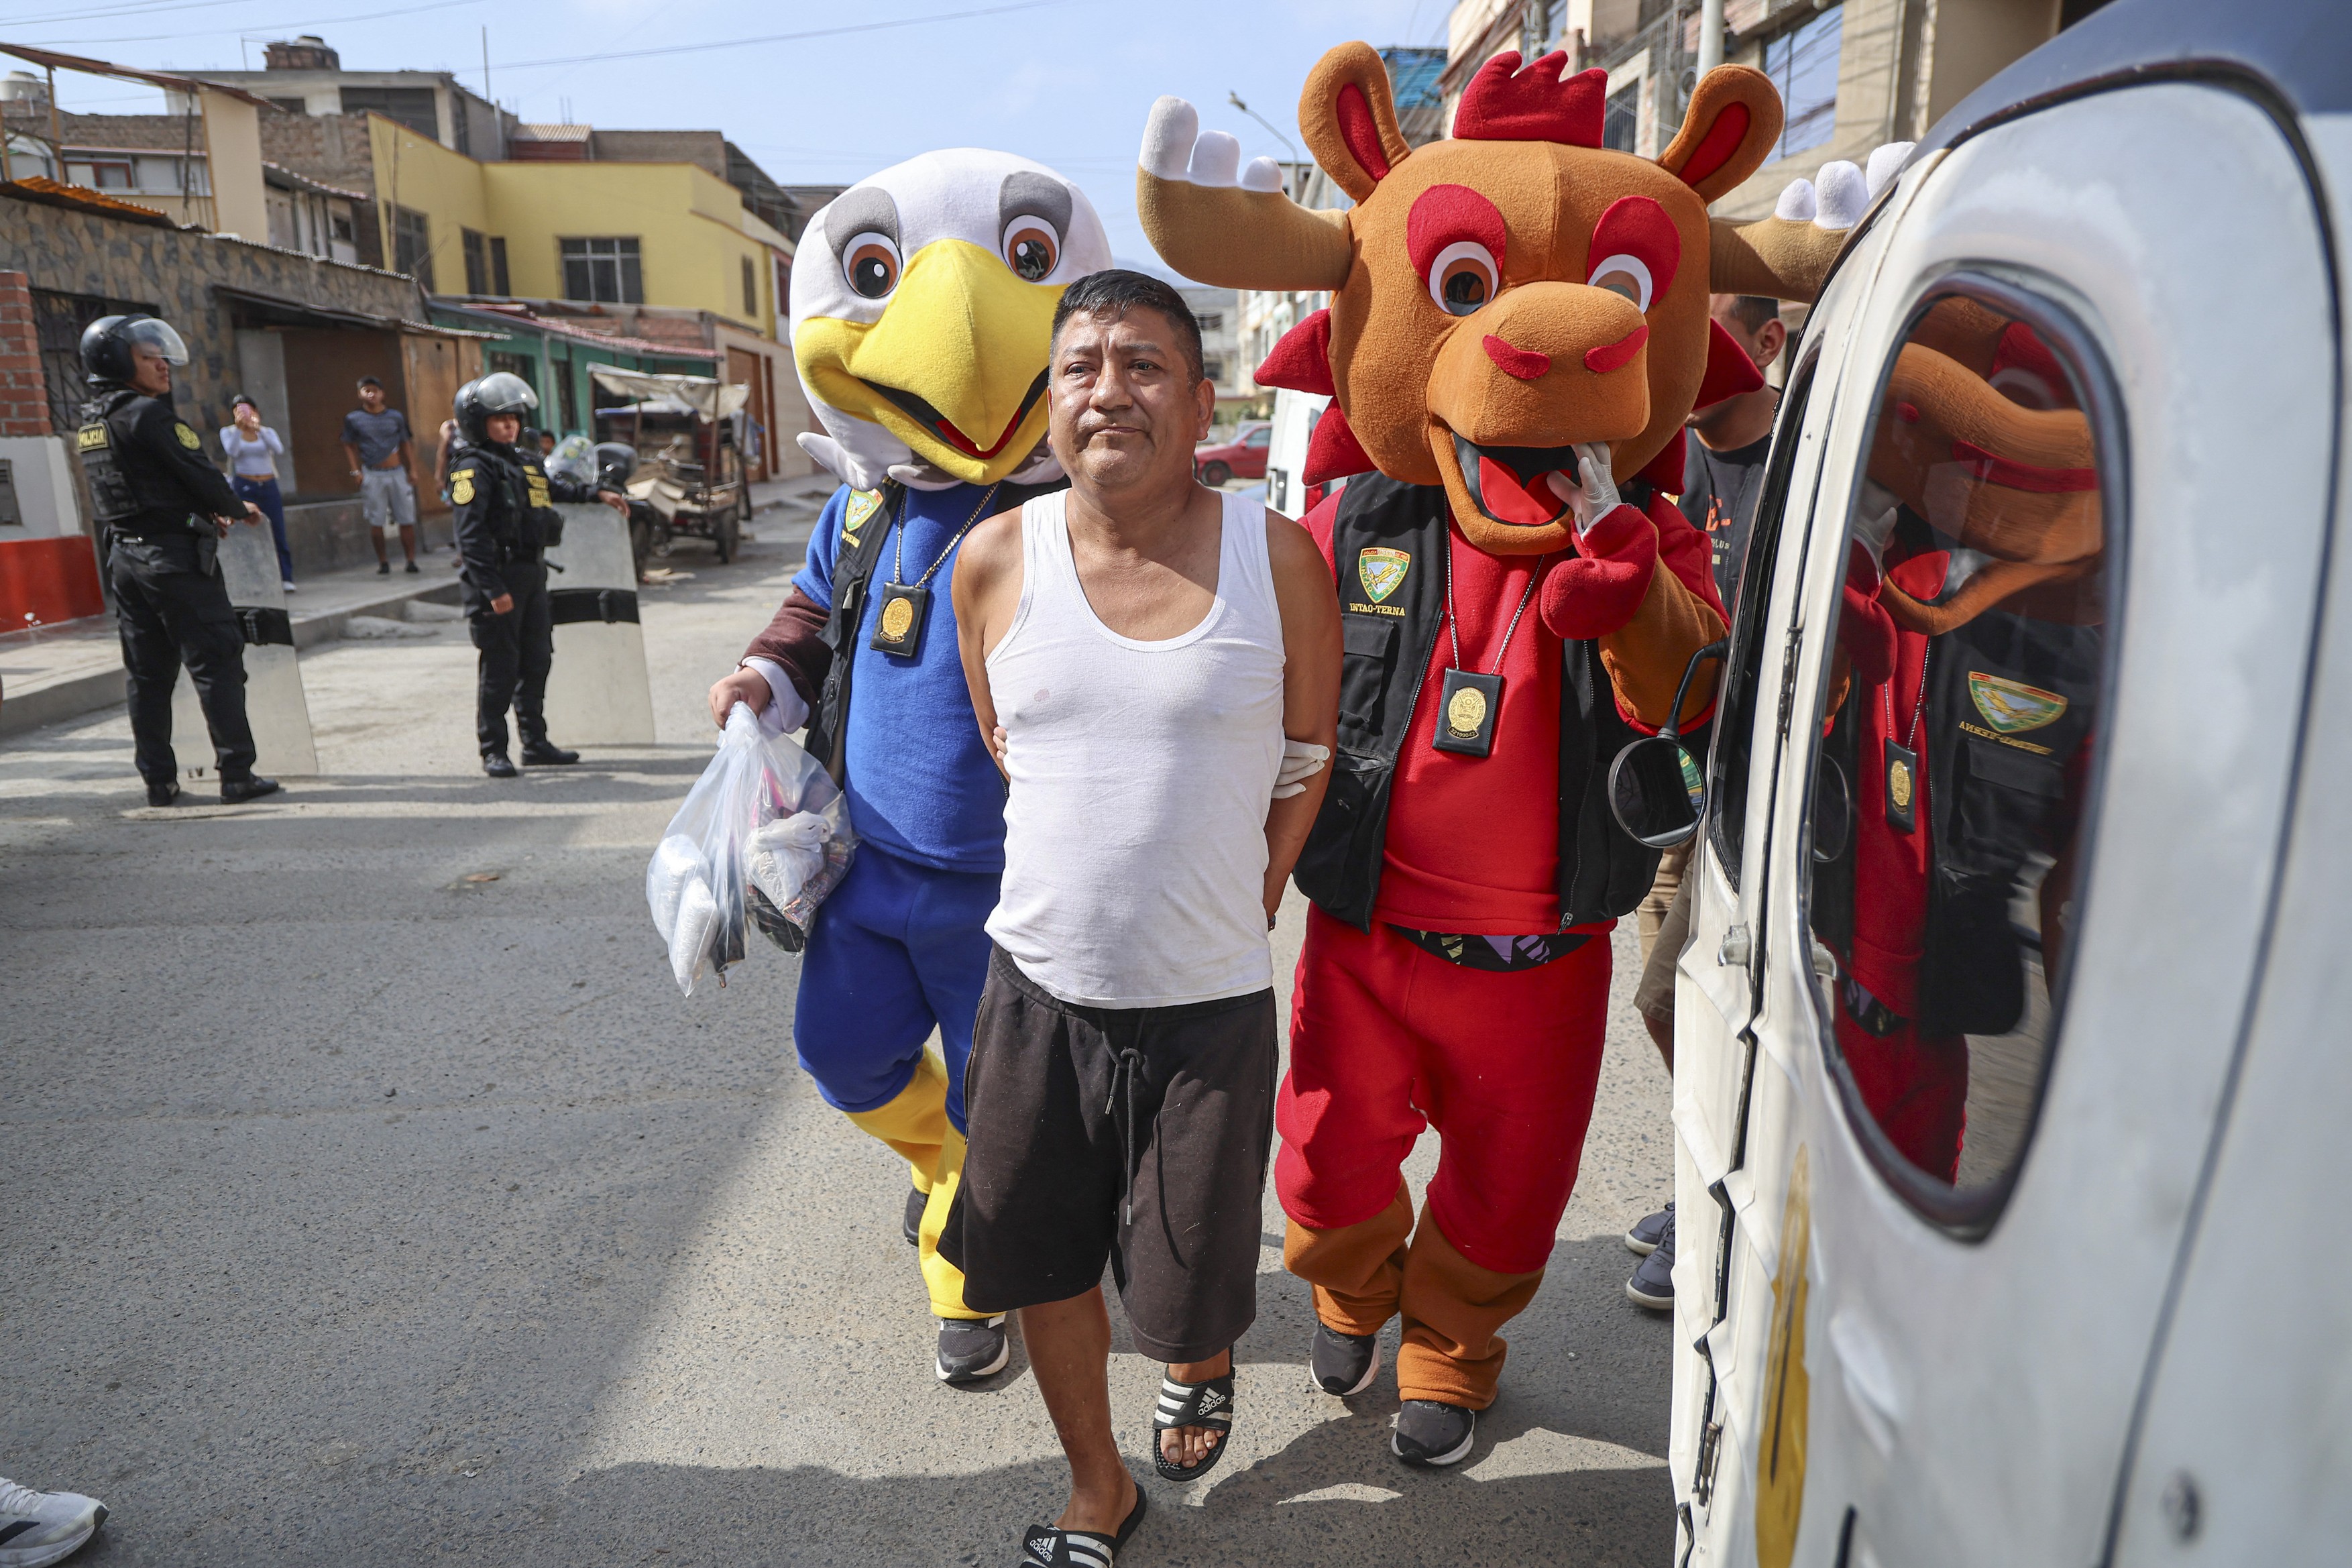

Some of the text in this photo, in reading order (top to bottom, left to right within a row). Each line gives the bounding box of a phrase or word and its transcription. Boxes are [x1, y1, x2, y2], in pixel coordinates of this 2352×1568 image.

[1349, 603, 1406, 616] INTAO-TERNA
[1450, 728, 1476, 738] 32199042
[1198, 1395, 1226, 1415] adidas
[1029, 1540, 1053, 1562] adidas
